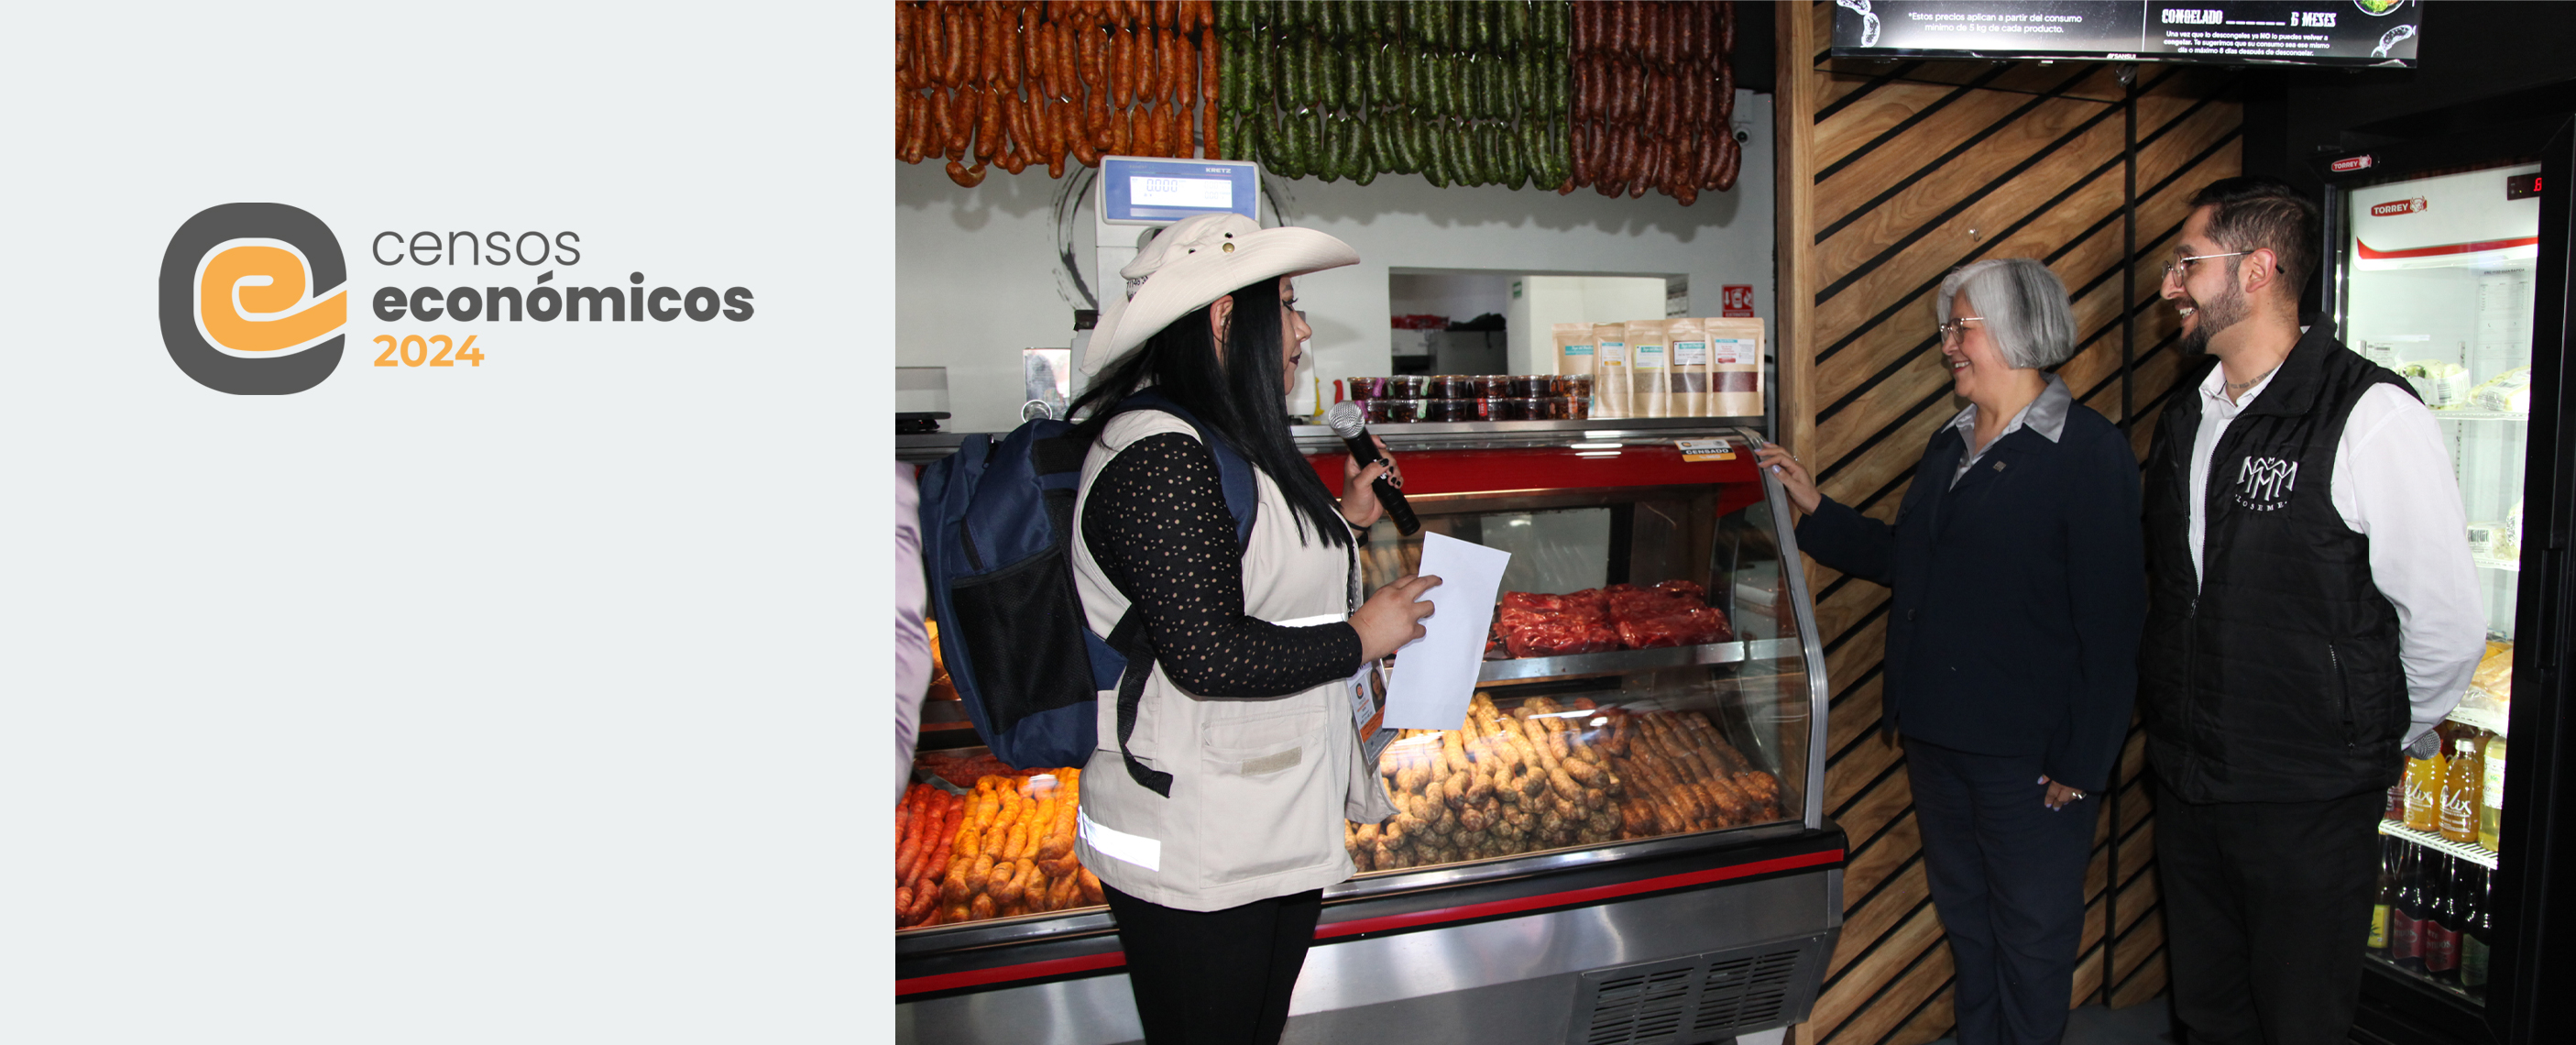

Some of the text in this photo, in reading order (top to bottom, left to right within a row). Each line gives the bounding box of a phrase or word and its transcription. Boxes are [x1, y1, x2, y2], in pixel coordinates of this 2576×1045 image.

[1935, 13, 1965, 22] precios
[1967, 13, 1996, 23] aplican
[2005, 14, 2028, 23] partir
[2030, 14, 2043, 22] del
[2162, 8, 2337, 28] CONGELADO 6 MESES
[1976, 24, 1987, 33] kg
[2023, 25, 2064, 34] producto.
[2212, 31, 2251, 40] descongeles
[2278, 33, 2302, 41] puedes
[2164, 38, 2192, 47] congelar.
[2202, 39, 2233, 48] sugerimos
[2334, 161, 2358, 170] TORREY
[2373, 203, 2408, 214] TORREY
